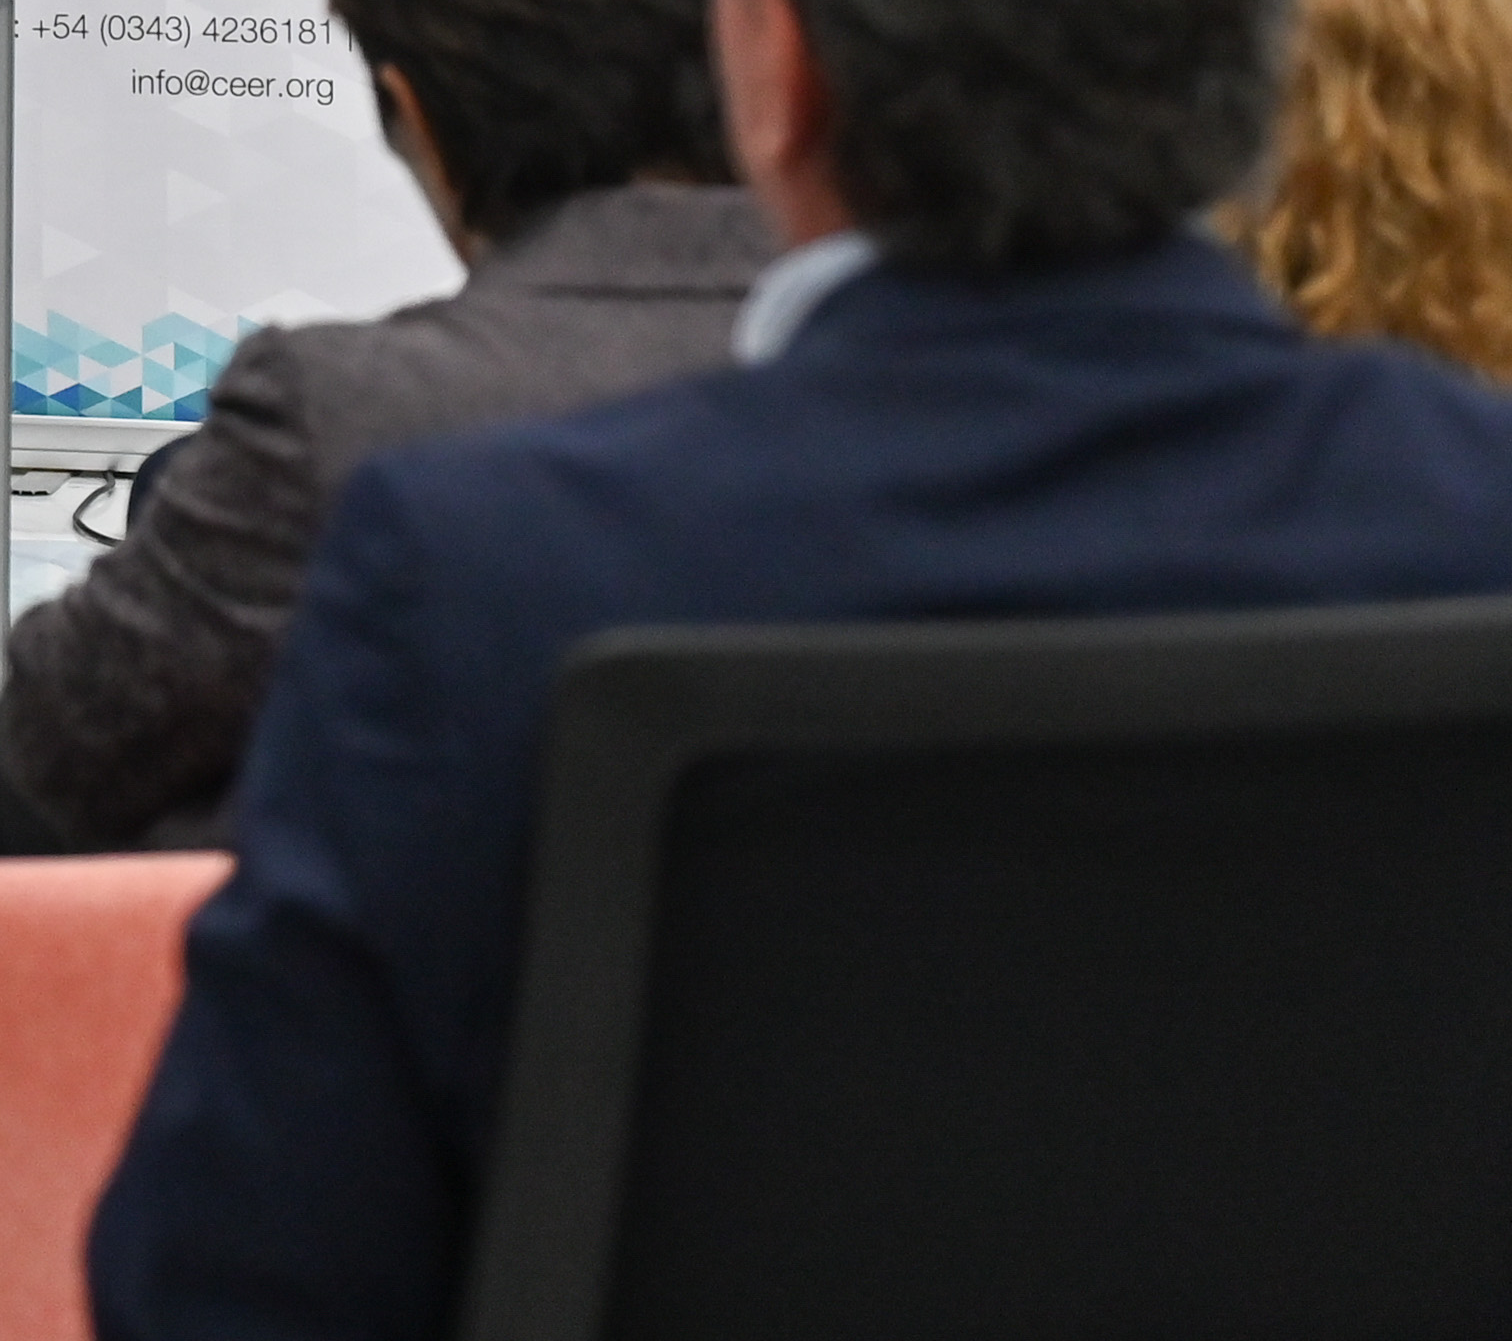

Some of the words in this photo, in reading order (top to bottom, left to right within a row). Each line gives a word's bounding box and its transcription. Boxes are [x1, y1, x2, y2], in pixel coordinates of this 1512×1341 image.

[31, 14, 90, 41] +54
[100, 14, 192, 49] (0343)
[202, 17, 332, 45] 4236181
[131, 68, 335, 107] info@ceer.org
